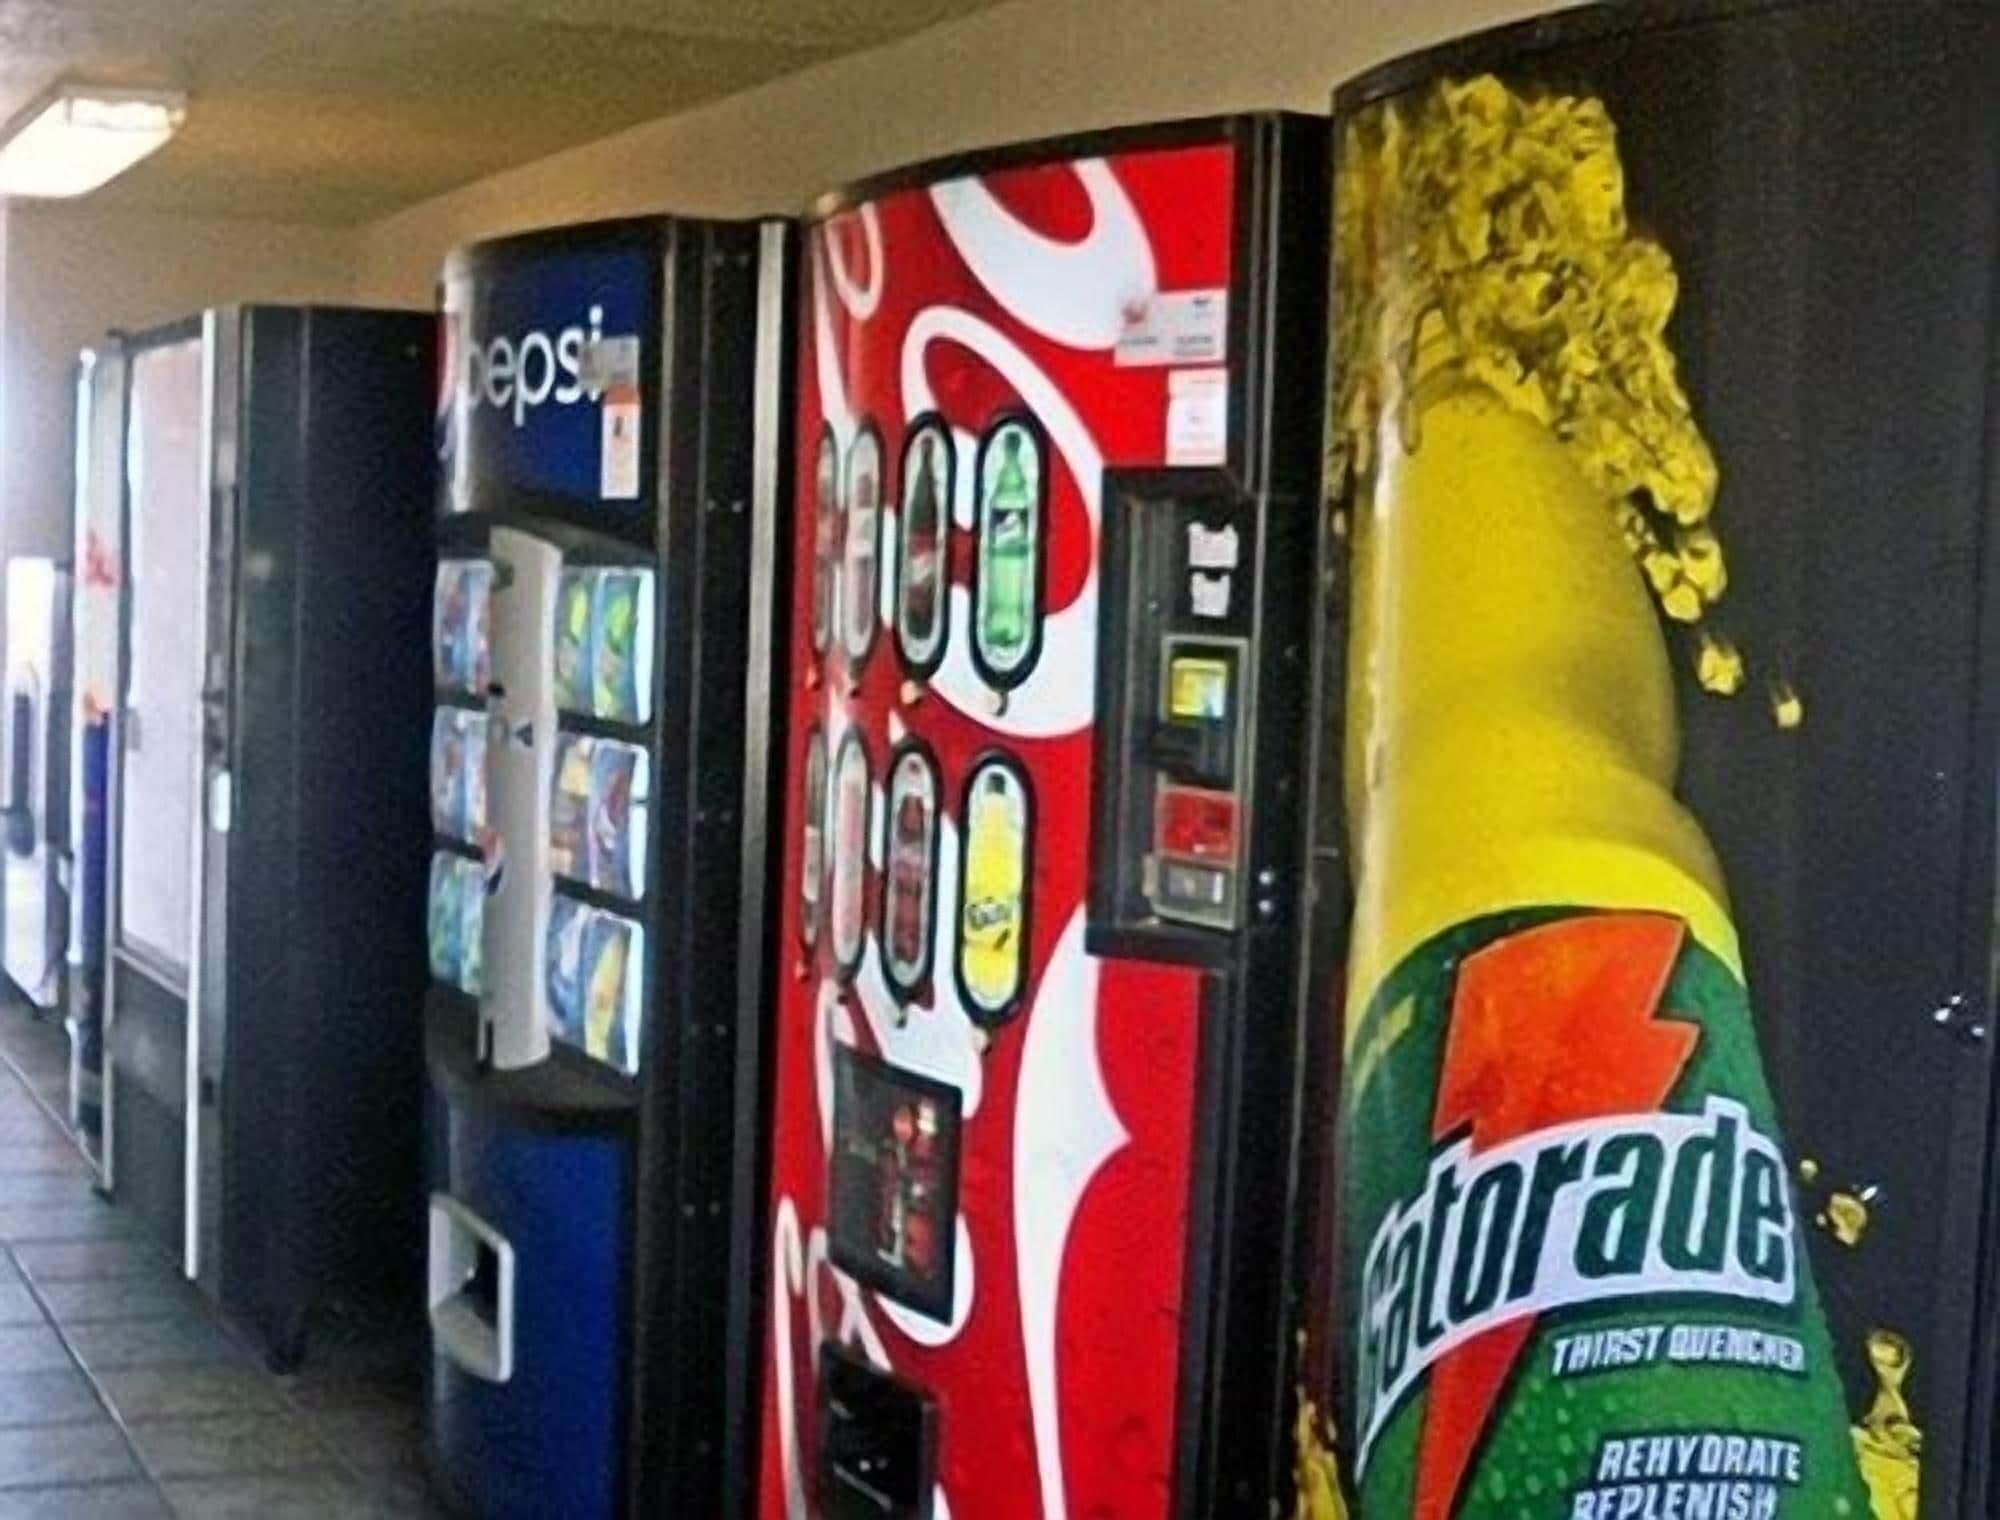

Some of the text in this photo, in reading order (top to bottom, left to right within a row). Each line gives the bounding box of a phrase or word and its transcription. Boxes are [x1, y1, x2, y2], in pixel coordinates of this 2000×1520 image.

[1551, 1325, 1665, 1377] THIRST
[1597, 1433, 1802, 1482] REHYDRATE
[1571, 1480, 1778, 1520] REPLENISH
